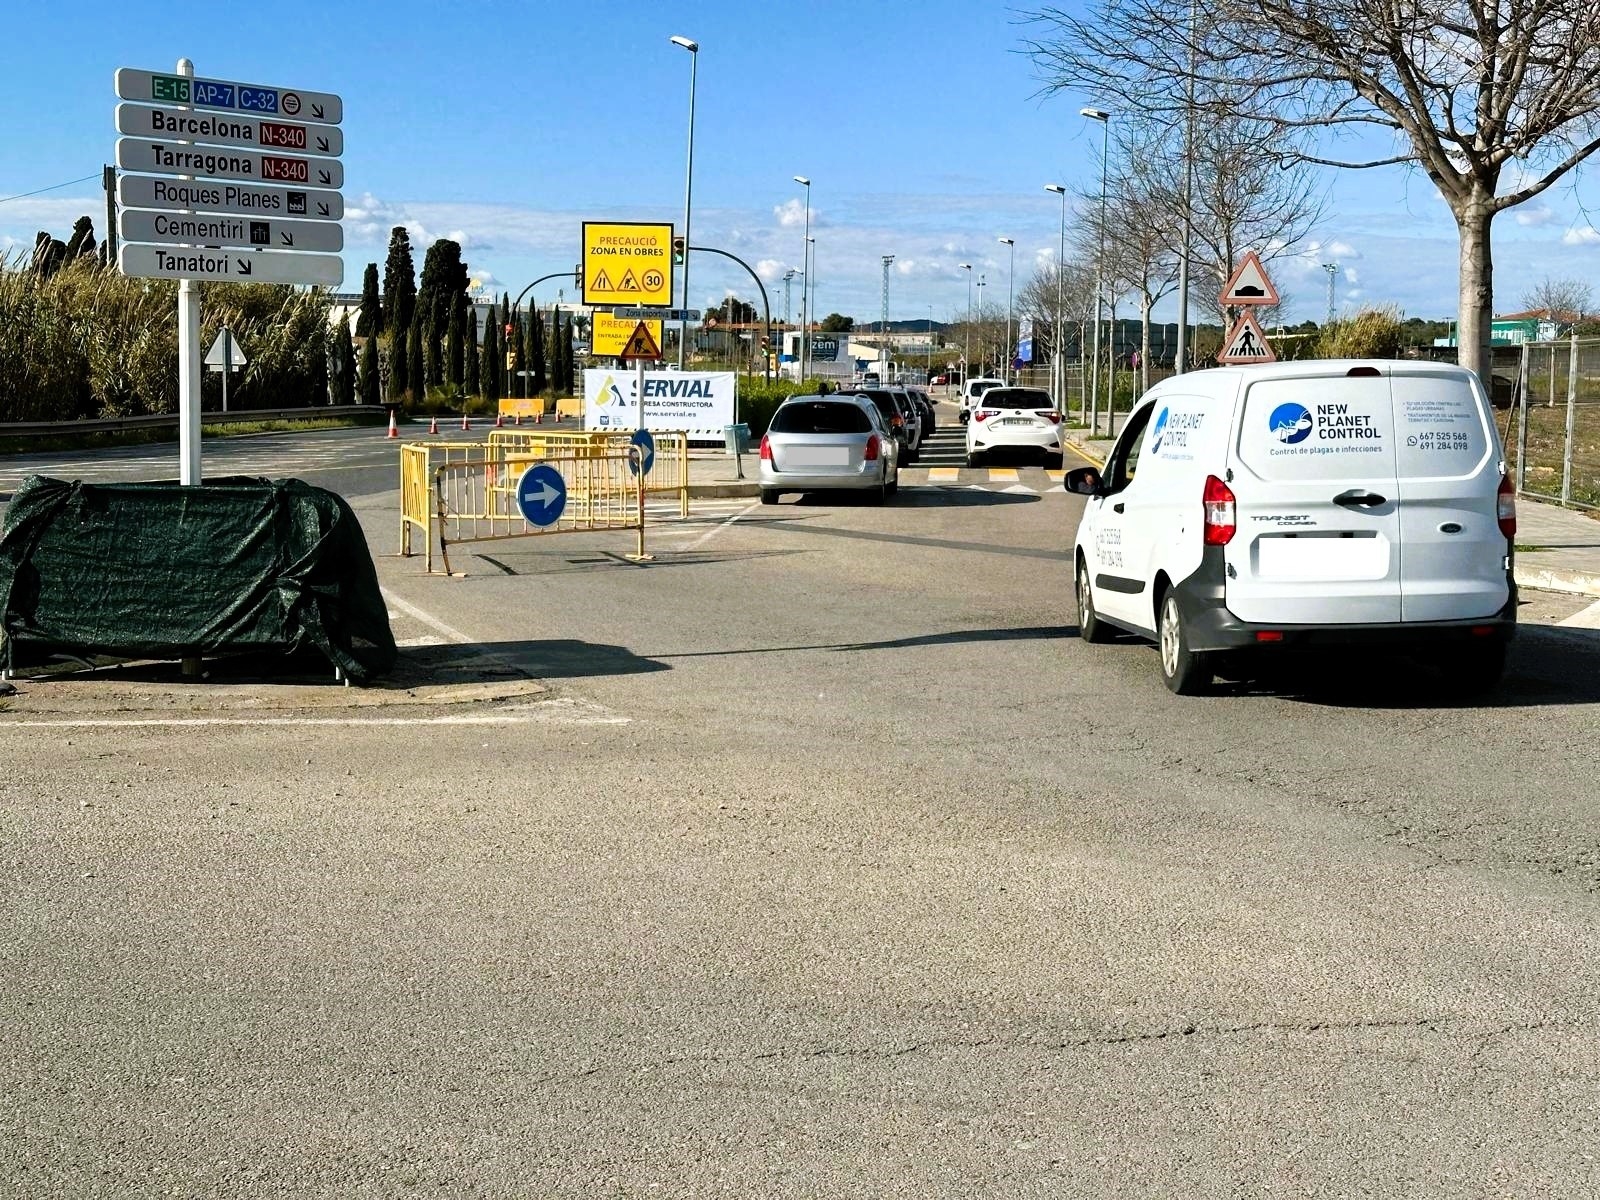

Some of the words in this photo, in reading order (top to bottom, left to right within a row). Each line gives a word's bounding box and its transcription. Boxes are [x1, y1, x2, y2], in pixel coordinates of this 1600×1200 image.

[153, 79, 189, 100] E-15
[196, 84, 232, 105] AP-7
[240, 89, 275, 110] C-32
[152, 110, 252, 140] Barcelona
[262, 126, 304, 146] N-340
[152, 145, 252, 174] Tarragona
[264, 160, 306, 180] N-340
[154, 181, 220, 207] Roques
[225, 186, 280, 209] Planes
[155, 215, 243, 239] Cementiri
[599, 236, 657, 246] PRECAUCIÓ
[591, 247, 617, 255] ZONA
[634, 248, 664, 256] OBRES
[155, 250, 228, 273] Tanatori
[646, 275, 661, 287] 30
[601, 320, 654, 329] PRECAUÓ
[812, 341, 835, 349] zem
[1317, 404, 1348, 415] NEW
[1318, 415, 1371, 427] PLANET
[1319, 428, 1381, 439] CONTROL
[1419, 432, 1434, 440] 667
[1436, 432, 1451, 440] 525
[1453, 432, 1467, 440] 568
[1270, 447, 1297, 456] Control
[1299, 447, 1308, 455] de
[1310, 447, 1334, 455] plagas
[1420, 442, 1434, 450] 691
[1437, 442, 1451, 450] 284
[1453, 442, 1468, 450] 098
